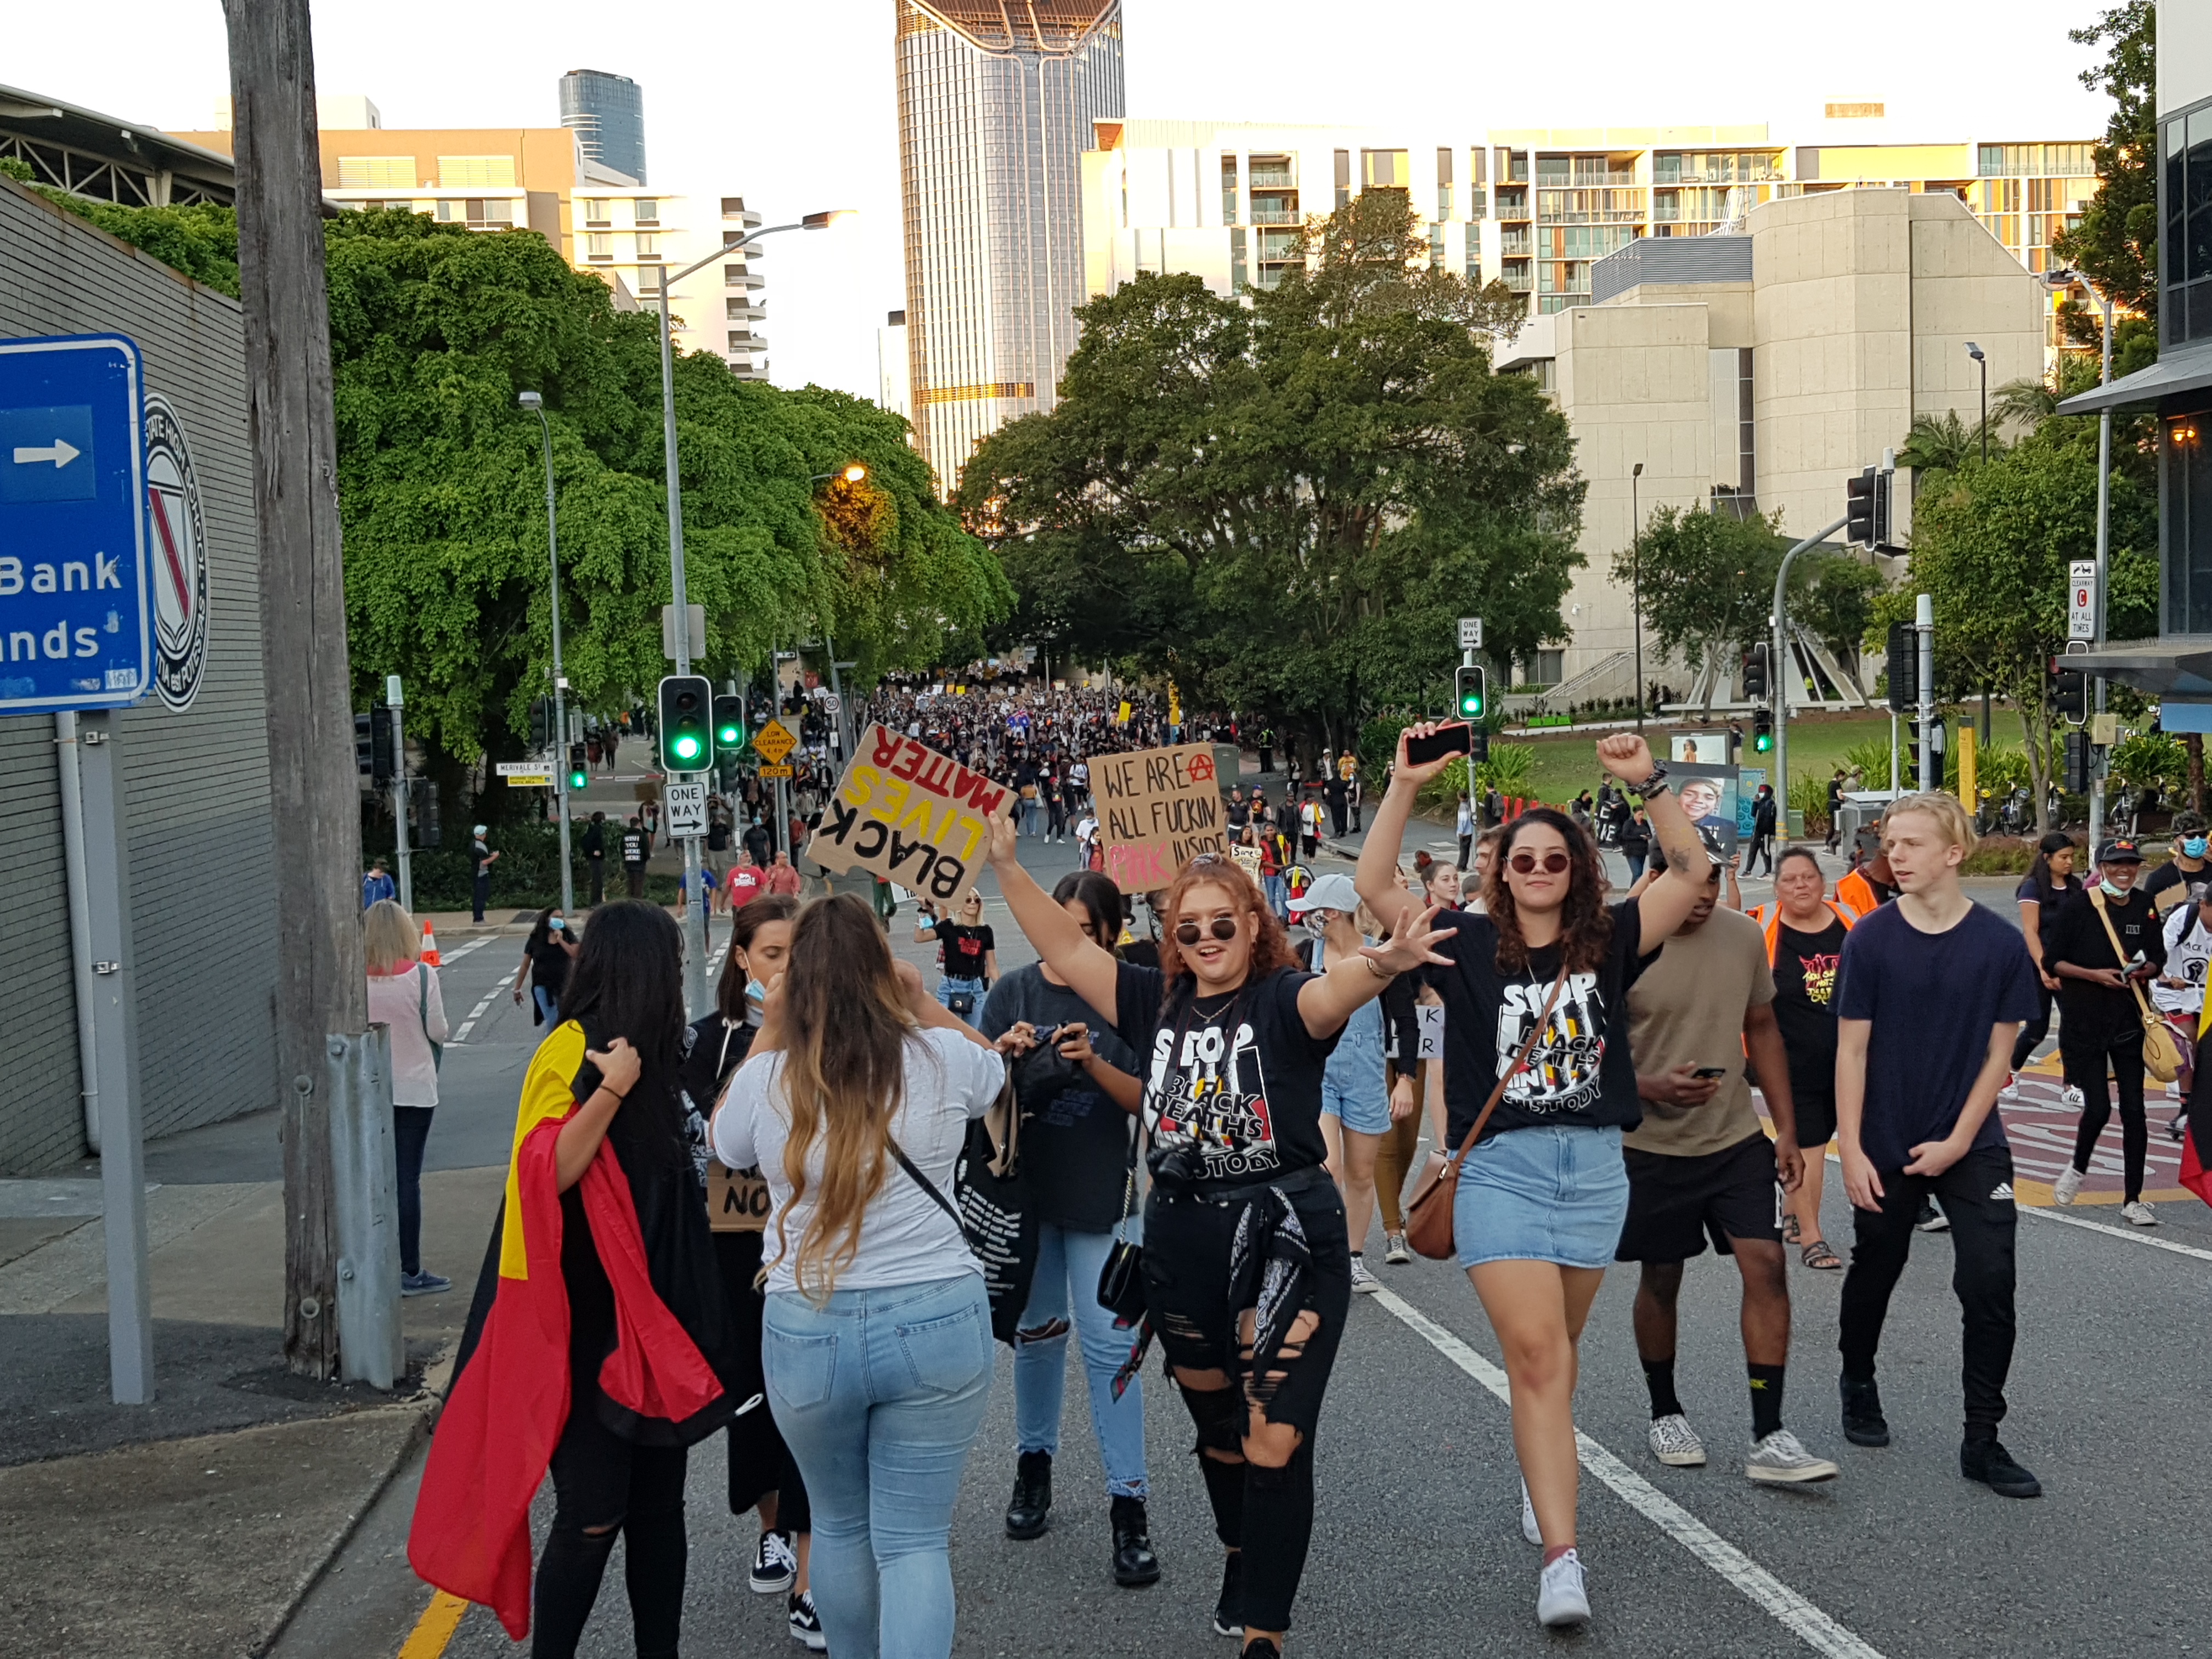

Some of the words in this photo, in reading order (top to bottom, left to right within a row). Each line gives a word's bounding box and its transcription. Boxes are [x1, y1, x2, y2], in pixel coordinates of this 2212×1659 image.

[145, 414, 165, 448] STATE
[165, 419, 186, 470] HIGH
[184, 465, 206, 578] SCHOOL
[2071, 612, 2078, 621] AT
[2081, 612, 2092, 621] ALL
[2073, 623, 2089, 633] TIMES
[0, 620, 99, 662] nds
[872, 725, 1006, 817] MATTER
[1103, 760, 1141, 799] WE
[1146, 752, 1190, 794] ARE
[670, 804, 702, 817] WAY
[671, 788, 699, 800] ONE
[844, 765, 984, 861] LIVES
[1108, 806, 1147, 840] ALL
[1150, 796, 1216, 834] FUCKIN
[819, 798, 965, 899] BLACK
[1108, 840, 1173, 888] PINK
[2185, 941, 2202, 951] ACK
[1503, 973, 1597, 1019] STOP
[1153, 1023, 1254, 1066] STOP
[1505, 1043, 1601, 1070] DEATHS
[1519, 1026, 1601, 1054] BLACK
[1166, 1074, 1261, 1117] BLACK
[1513, 1069, 1540, 1088] IN
[1150, 1090, 1265, 1139] DEATHS
[1196, 1150, 1280, 1180] STODY
[723, 1185, 770, 1218] NO
